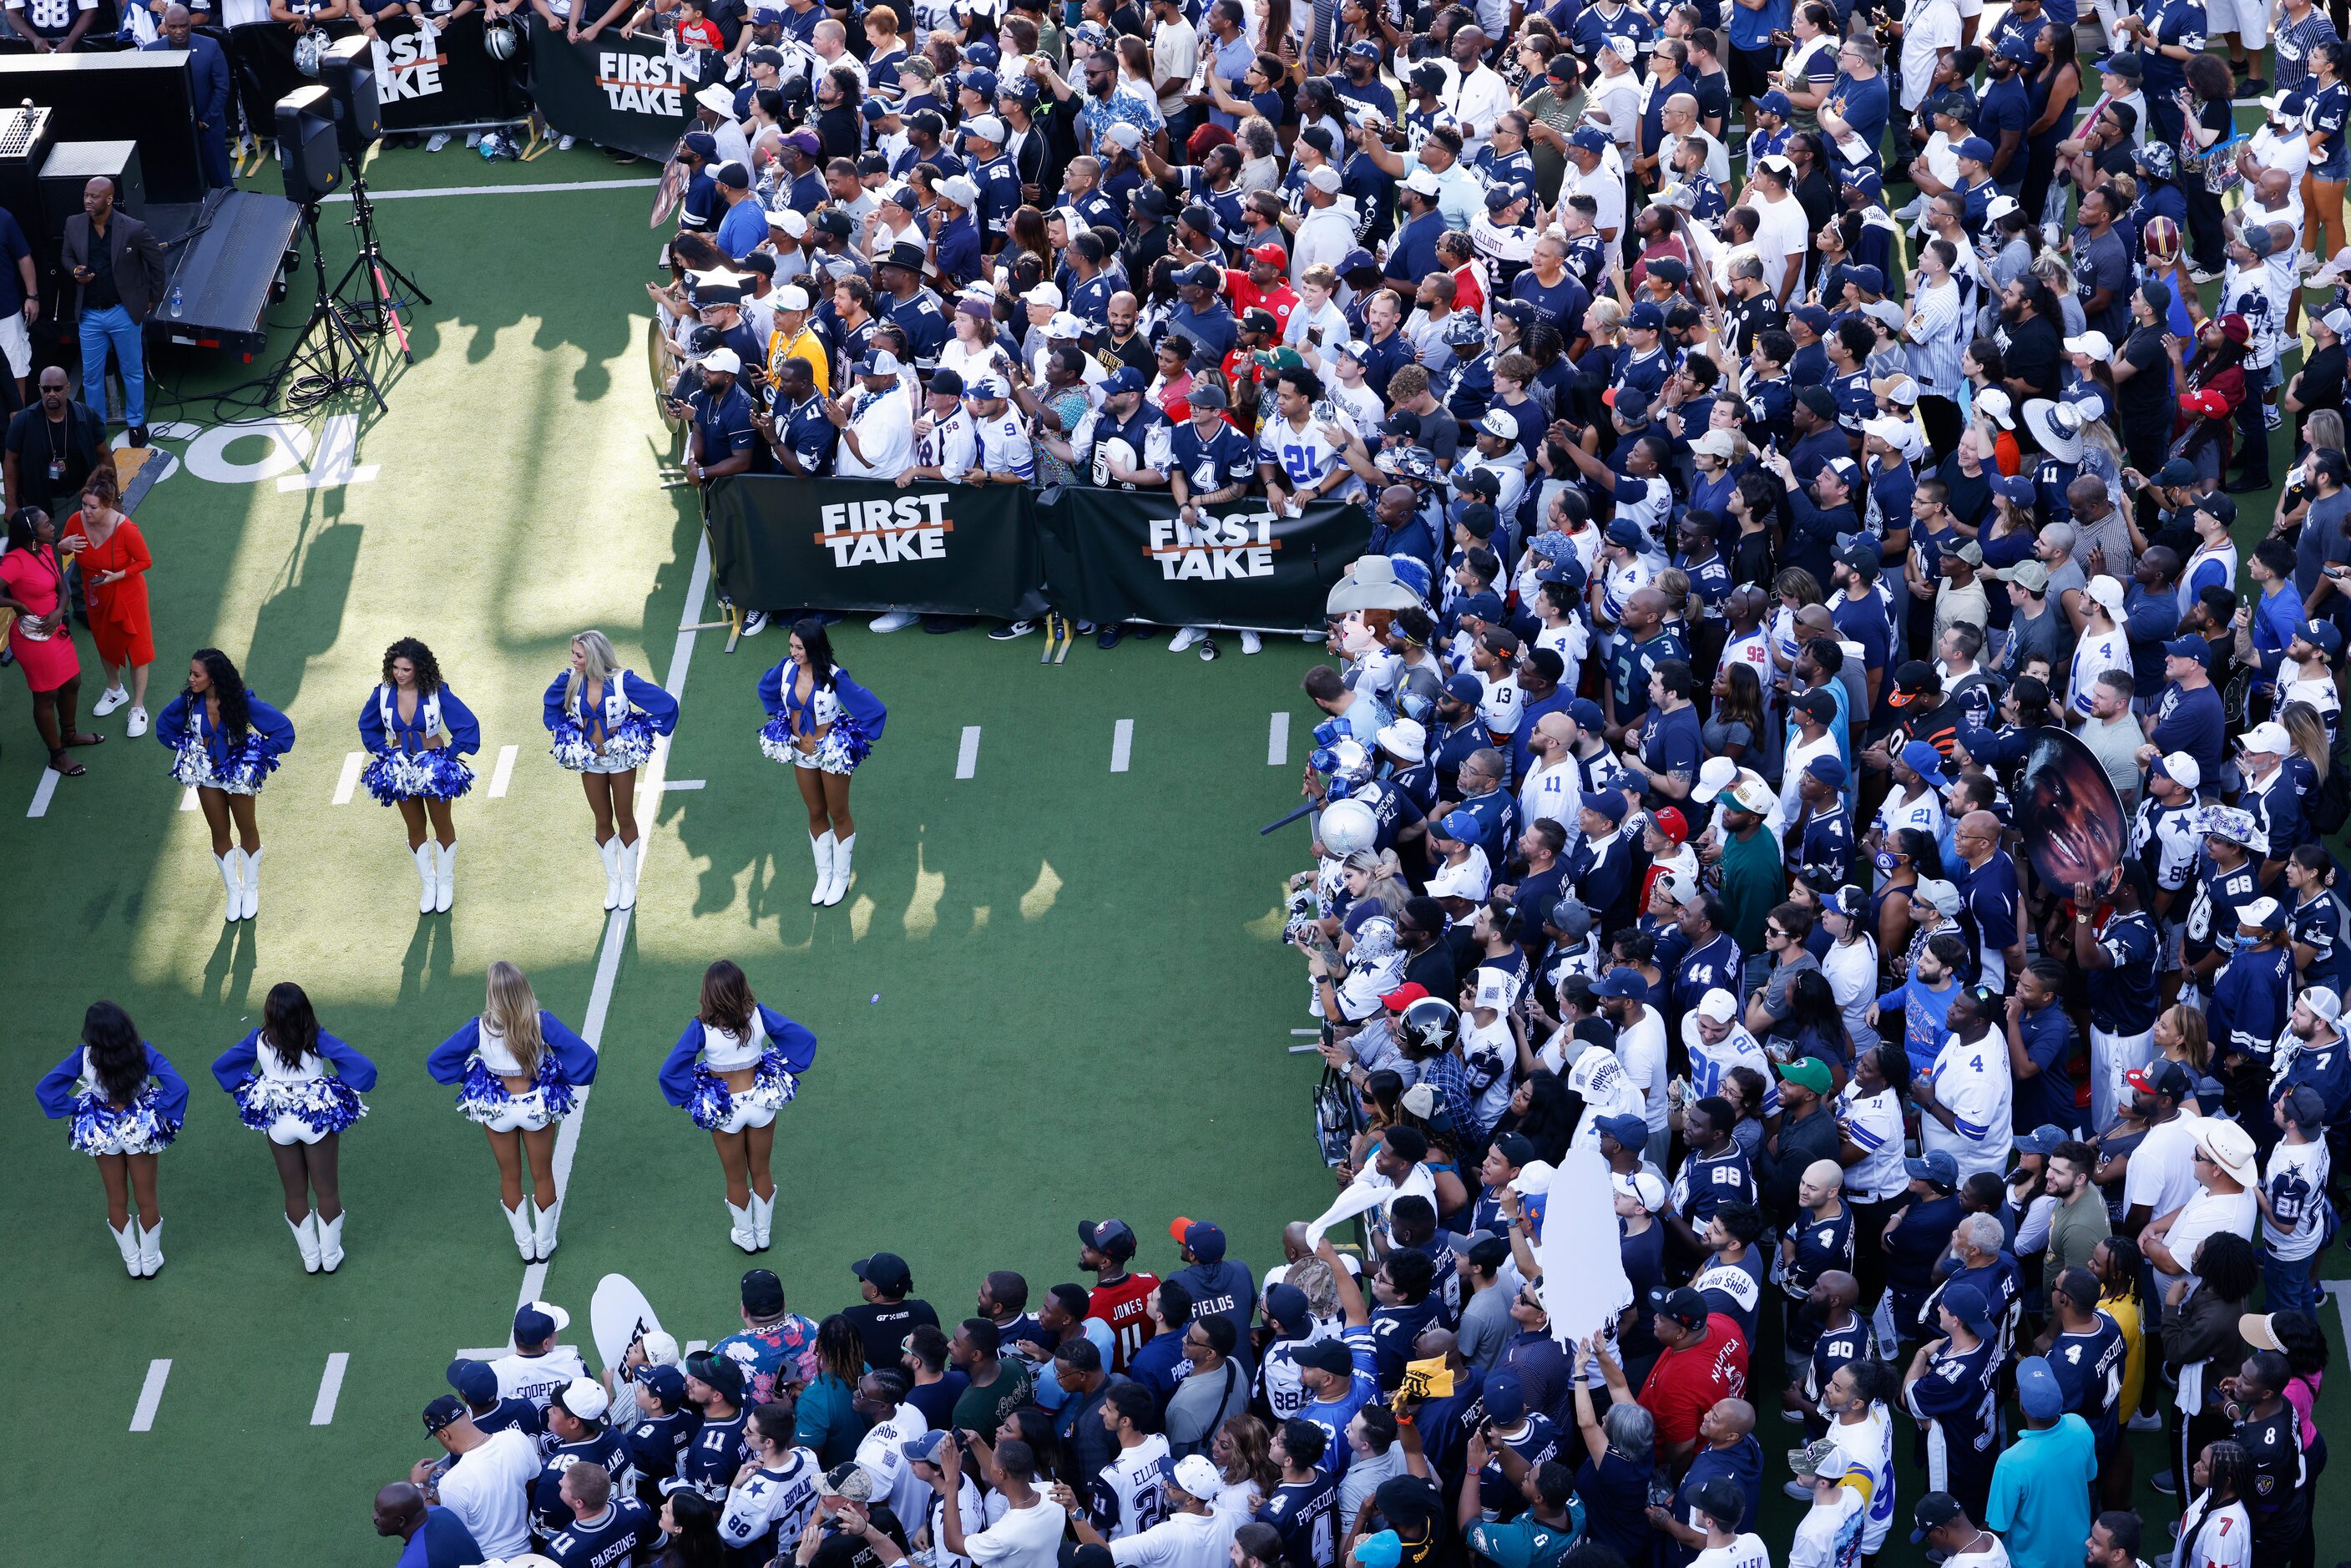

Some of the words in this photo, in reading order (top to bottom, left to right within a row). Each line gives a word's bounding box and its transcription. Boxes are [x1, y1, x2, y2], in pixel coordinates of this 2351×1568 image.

[599, 52, 685, 87] FIRST
[603, 82, 684, 117] TAKE
[988, 164, 1011, 180] 55
[1983, 187, 1997, 199] 11
[1475, 229, 1504, 254] ELLIOTT
[1090, 284, 1102, 298] 4
[1762, 297, 1777, 312] 90
[1097, 348, 1124, 371] NINER
[1657, 357, 1668, 372] 4
[1327, 385, 1362, 420] DALLAS
[806, 408, 822, 420] 11
[946, 421, 960, 433] 58
[1004, 422, 1017, 437] 9
[1283, 444, 1324, 483] 21
[1191, 459, 1219, 495] 4
[2042, 466, 2058, 484] 11
[821, 493, 949, 537] FIRST
[1149, 513, 1279, 550] FRST
[825, 528, 947, 569] TAKE
[1153, 544, 1275, 581] TAKE
[1701, 564, 1727, 580] 55
[1625, 570, 1636, 584] 4
[1555, 637, 1566, 653] 4
[1661, 640, 1675, 655] 3
[1747, 646, 1766, 664] 92
[2100, 642, 2112, 659] 4
[1616, 655, 1631, 706] 3
[1495, 688, 1512, 704] 13
[1471, 727, 1483, 741] 4
[1398, 773, 1416, 788] 11
[1544, 776, 1561, 793] 11
[1383, 807, 1398, 828] BALL
[1910, 808, 1930, 825] 21
[1828, 820, 1843, 837] 4
[2226, 876, 2253, 896] 88
[2314, 897, 2331, 910] 88
[1687, 963, 1713, 984] 44
[1732, 1034, 1757, 1055] 21
[1969, 1055, 1984, 1072] 4
[2316, 1052, 2332, 1070] 7
[1464, 1065, 1491, 1089] 88
[1689, 1045, 1721, 1100] 21
[1872, 1099, 1883, 1110] 11
[1711, 1166, 1742, 1187] 88
[2275, 1196, 2300, 1218] 21
[1818, 1227, 1835, 1249] 4
[1723, 1277, 1748, 1297] SHOP
[1112, 1297, 1144, 1321] JONES
[1191, 1295, 1235, 1318] FIELDS
[877, 1313, 889, 1323] GT
[1120, 1322, 1142, 1368] 11
[1827, 1341, 1853, 1358] 90
[2065, 1343, 2083, 1366] 4
[1711, 1338, 1740, 1385] NAUTICA
[2095, 1334, 2124, 1378] PRESCOTT
[517, 1379, 562, 1399] COOPER
[1274, 1391, 1300, 1411] 88
[703, 1429, 725, 1453] 11
[2263, 1426, 2276, 1445] 8
[547, 1453, 581, 1473] 88
[1268, 1494, 1288, 1515] 4
[1295, 1485, 1337, 1527] PRESCOTT
[727, 1514, 752, 1538] 88
[2219, 1516, 2235, 1537] 7
[550, 1532, 576, 1557] 11
[589, 1531, 637, 1568] PARSONS
[1311, 1510, 1335, 1568] 4
